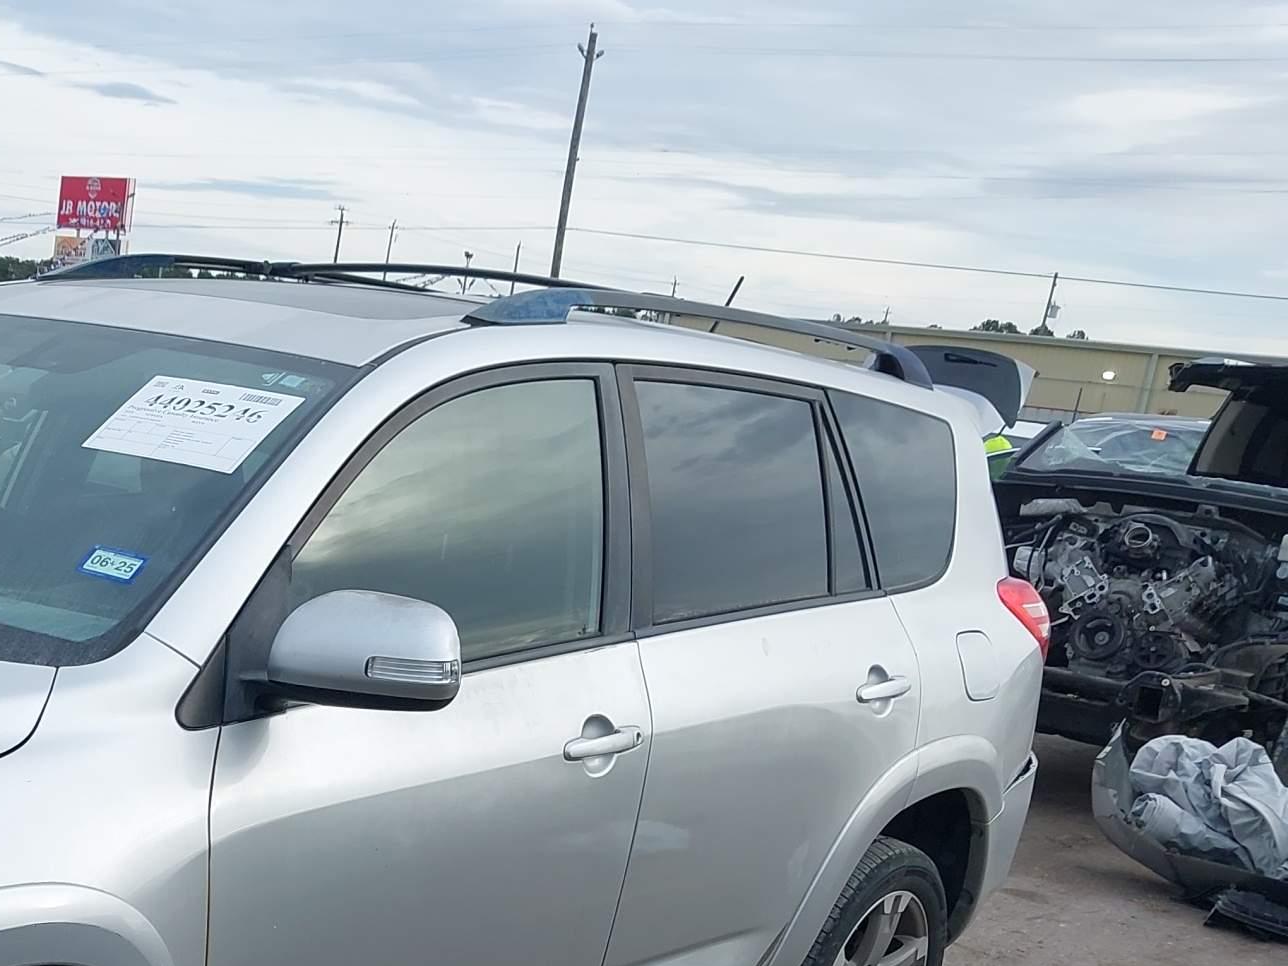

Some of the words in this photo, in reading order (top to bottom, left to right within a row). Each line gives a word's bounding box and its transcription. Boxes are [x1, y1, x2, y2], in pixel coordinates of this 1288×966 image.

[60, 200, 73, 215] JR
[144, 393, 269, 424] 44025246
[90, 555, 111, 568] 06
[114, 560, 137, 574] 25
